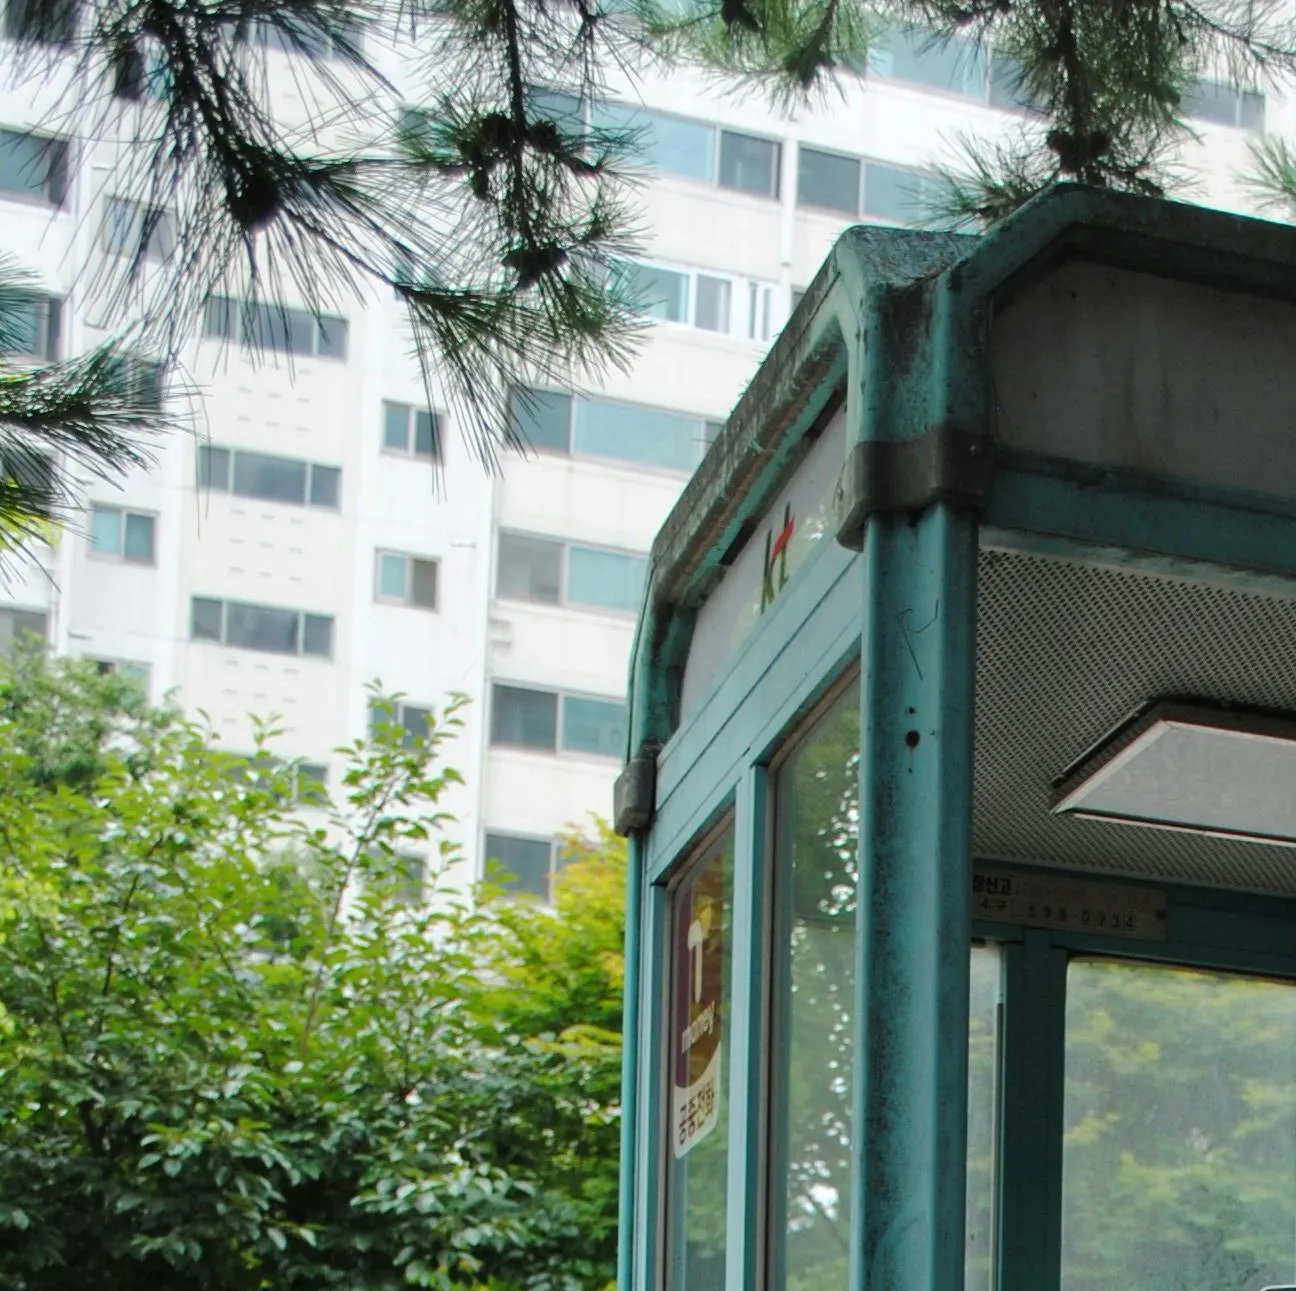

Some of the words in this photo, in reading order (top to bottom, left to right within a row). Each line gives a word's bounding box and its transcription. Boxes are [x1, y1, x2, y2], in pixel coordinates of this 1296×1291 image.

[760, 502, 795, 615] kt
[681, 1000, 716, 1054] money
[678, 1078, 715, 1145] 공중전화
